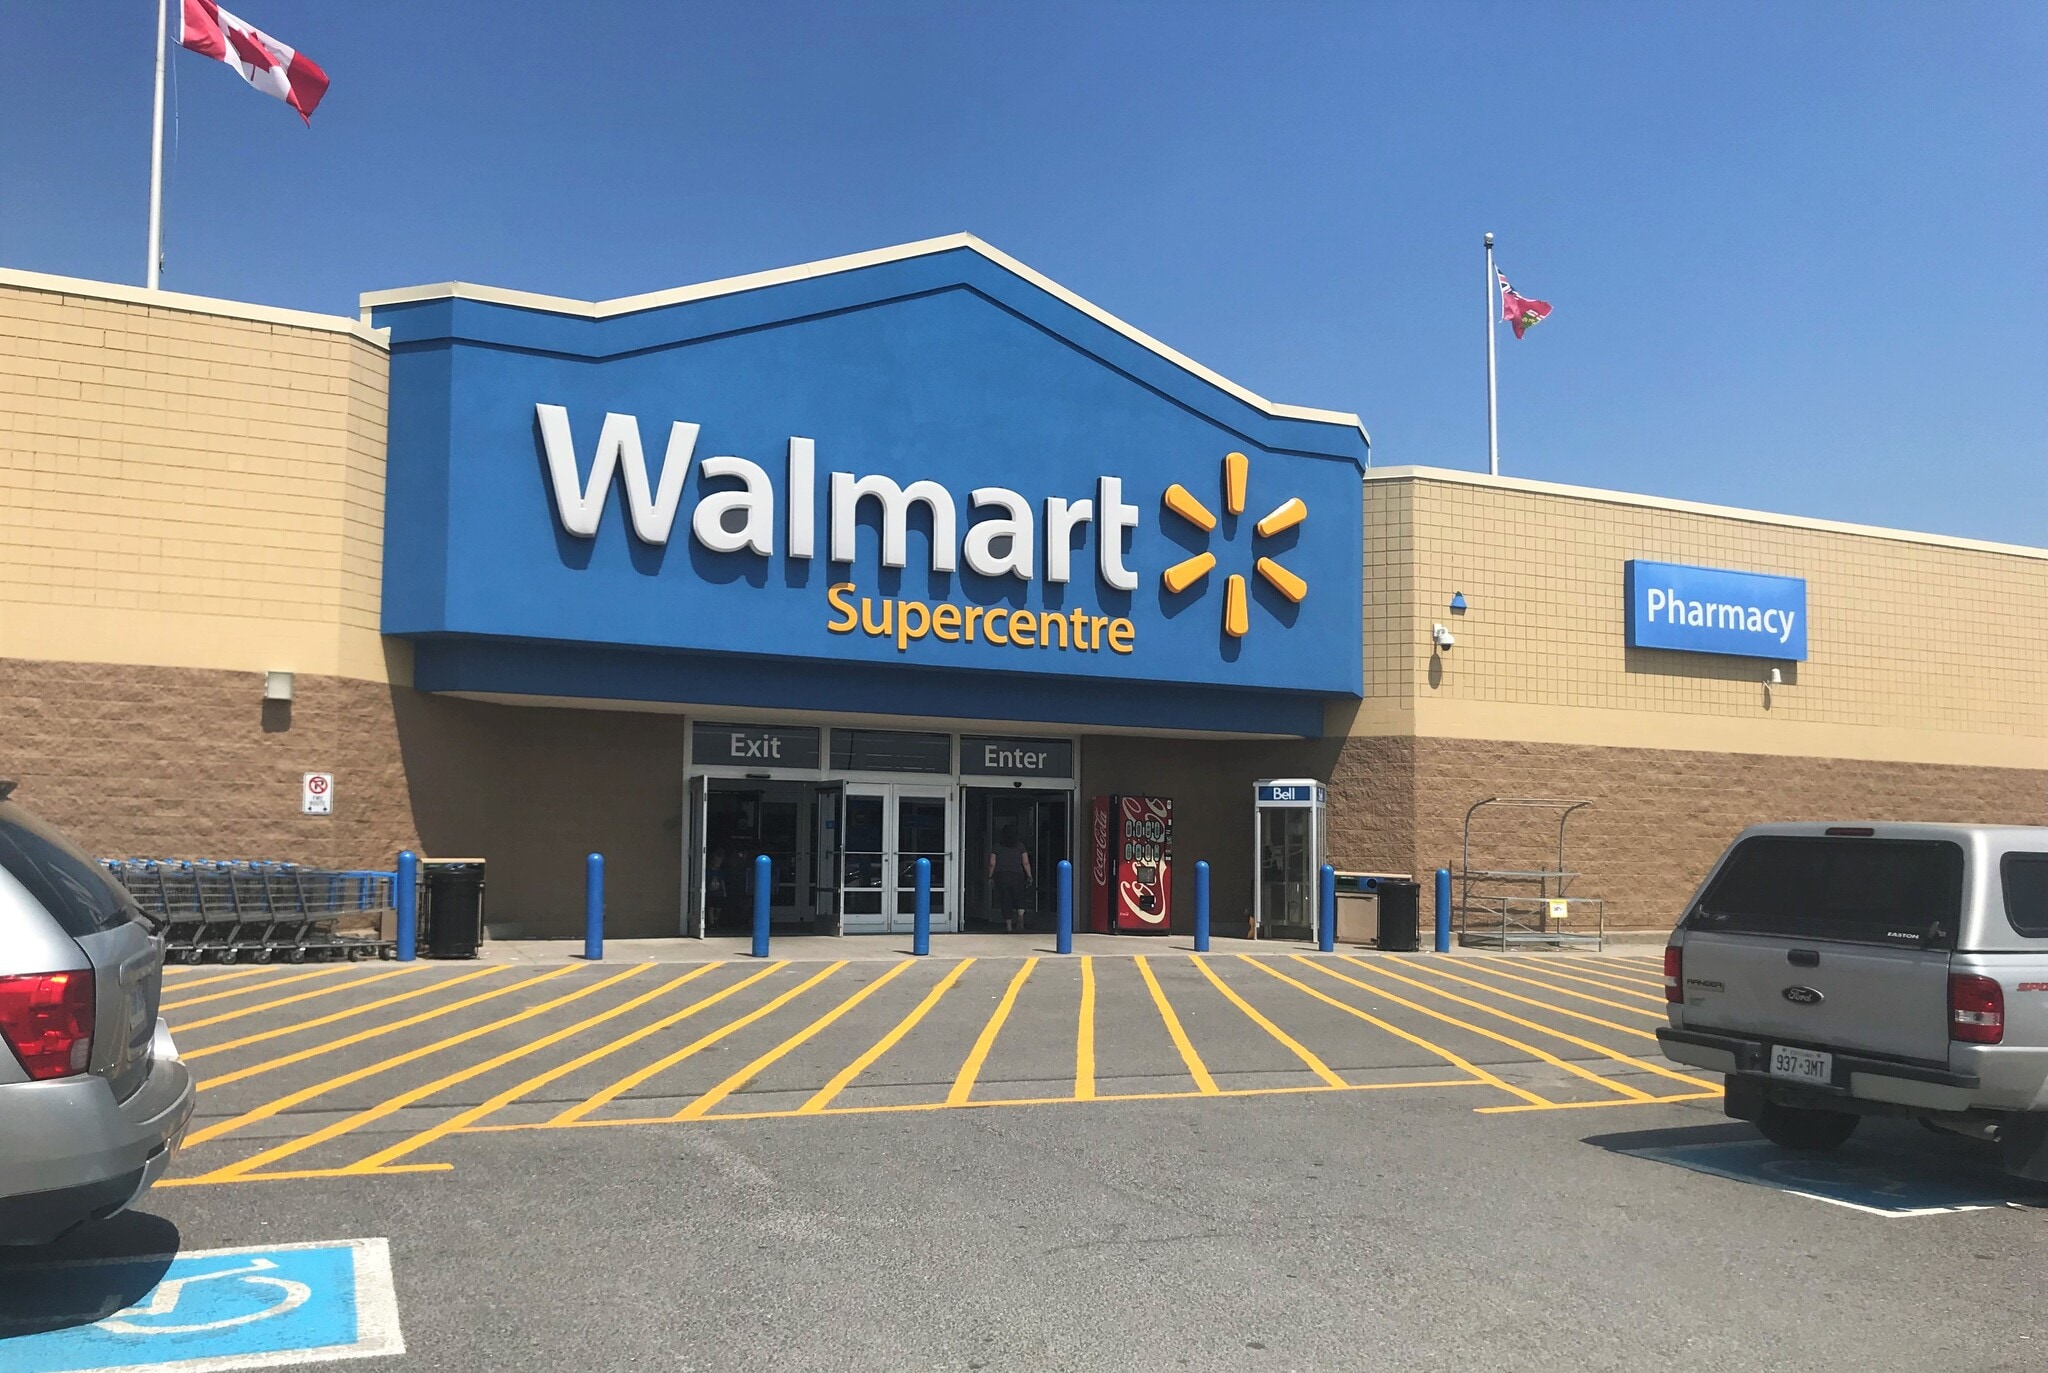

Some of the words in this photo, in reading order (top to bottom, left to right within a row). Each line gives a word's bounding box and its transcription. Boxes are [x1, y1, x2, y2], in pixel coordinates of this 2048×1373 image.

[536, 404, 1139, 590] Walmart
[827, 583, 1134, 652] Supercentre
[1647, 588, 1795, 644] Pharmacy
[730, 733, 781, 758] Exit
[984, 744, 1048, 769] Enter
[1273, 787, 1295, 800] Bell
[1093, 807, 1108, 886] Coca-Cola
[1887, 931, 1920, 940] EASTON
[1787, 988, 1812, 1002] Ford
